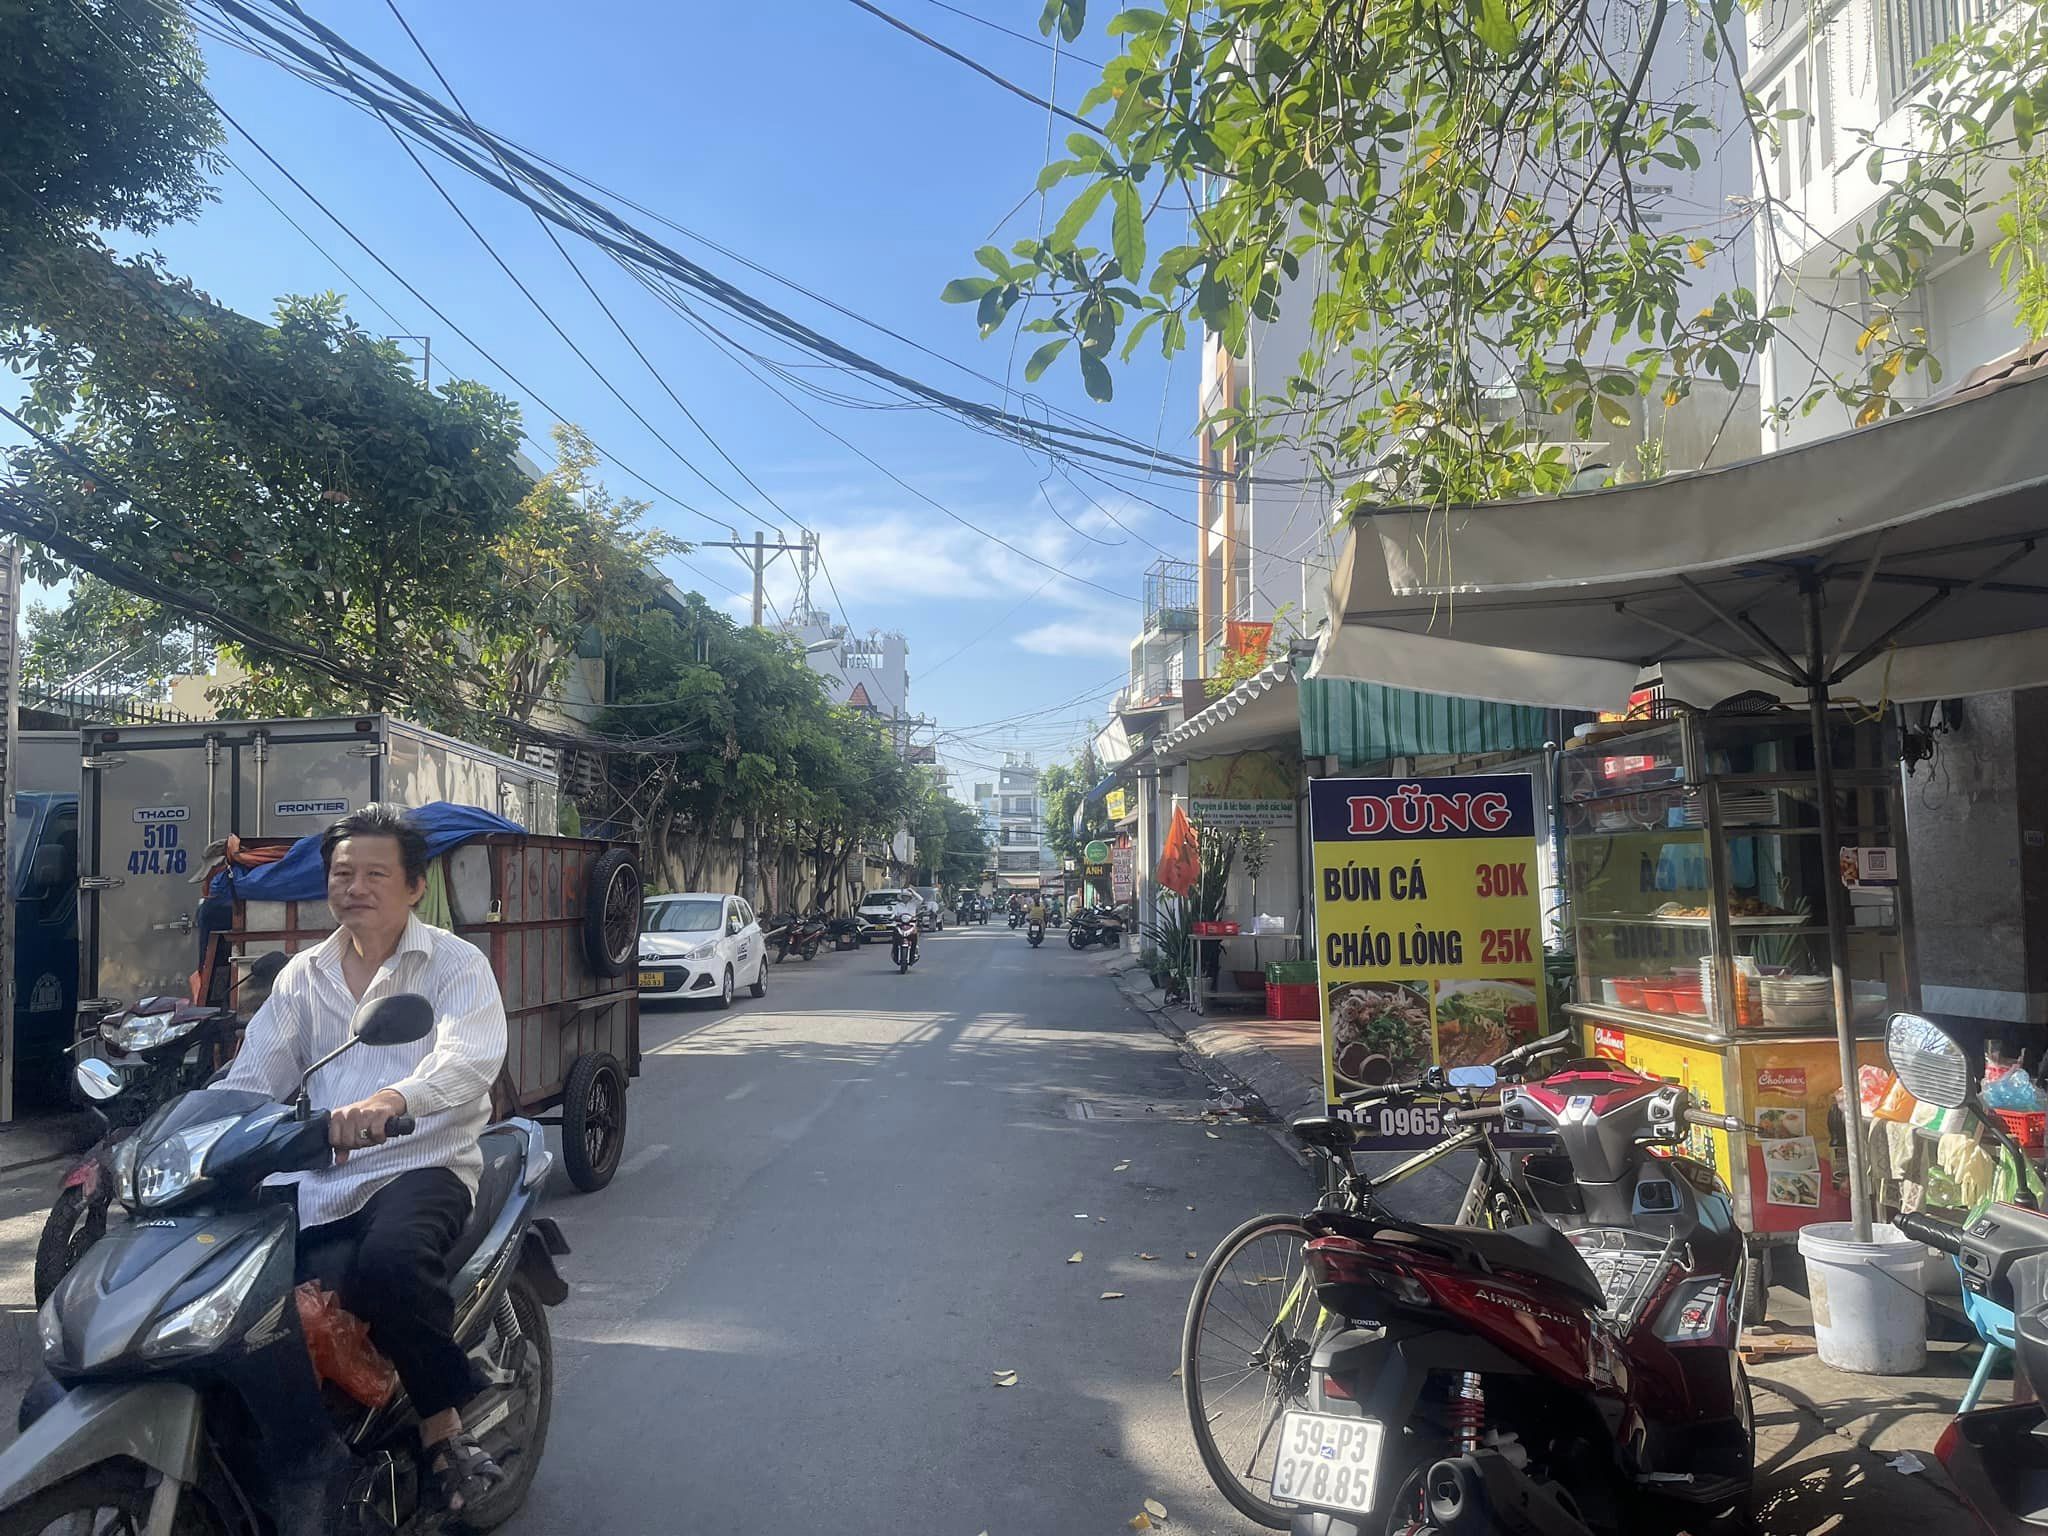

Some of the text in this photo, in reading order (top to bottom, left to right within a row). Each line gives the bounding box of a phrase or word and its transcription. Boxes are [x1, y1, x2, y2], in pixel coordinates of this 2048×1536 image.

[138, 809, 185, 819] THACO
[278, 801, 345, 813] FRONTIER
[1346, 784, 1512, 834] DŨNG
[143, 824, 178, 849] 51D
[127, 849, 187, 875] 474.78
[1086, 866, 1103, 876] ANH
[1323, 858, 1529, 902] BÚN CÁ 30K
[1326, 922, 1534, 968] CHÁO LÒNG 25K
[1758, 1070, 1805, 1086] Cholimex
[1350, 1318, 1381, 1327] HONDA
[1294, 1418, 1369, 1463] 59-P3
[1279, 1458, 1370, 1507] 378.85
